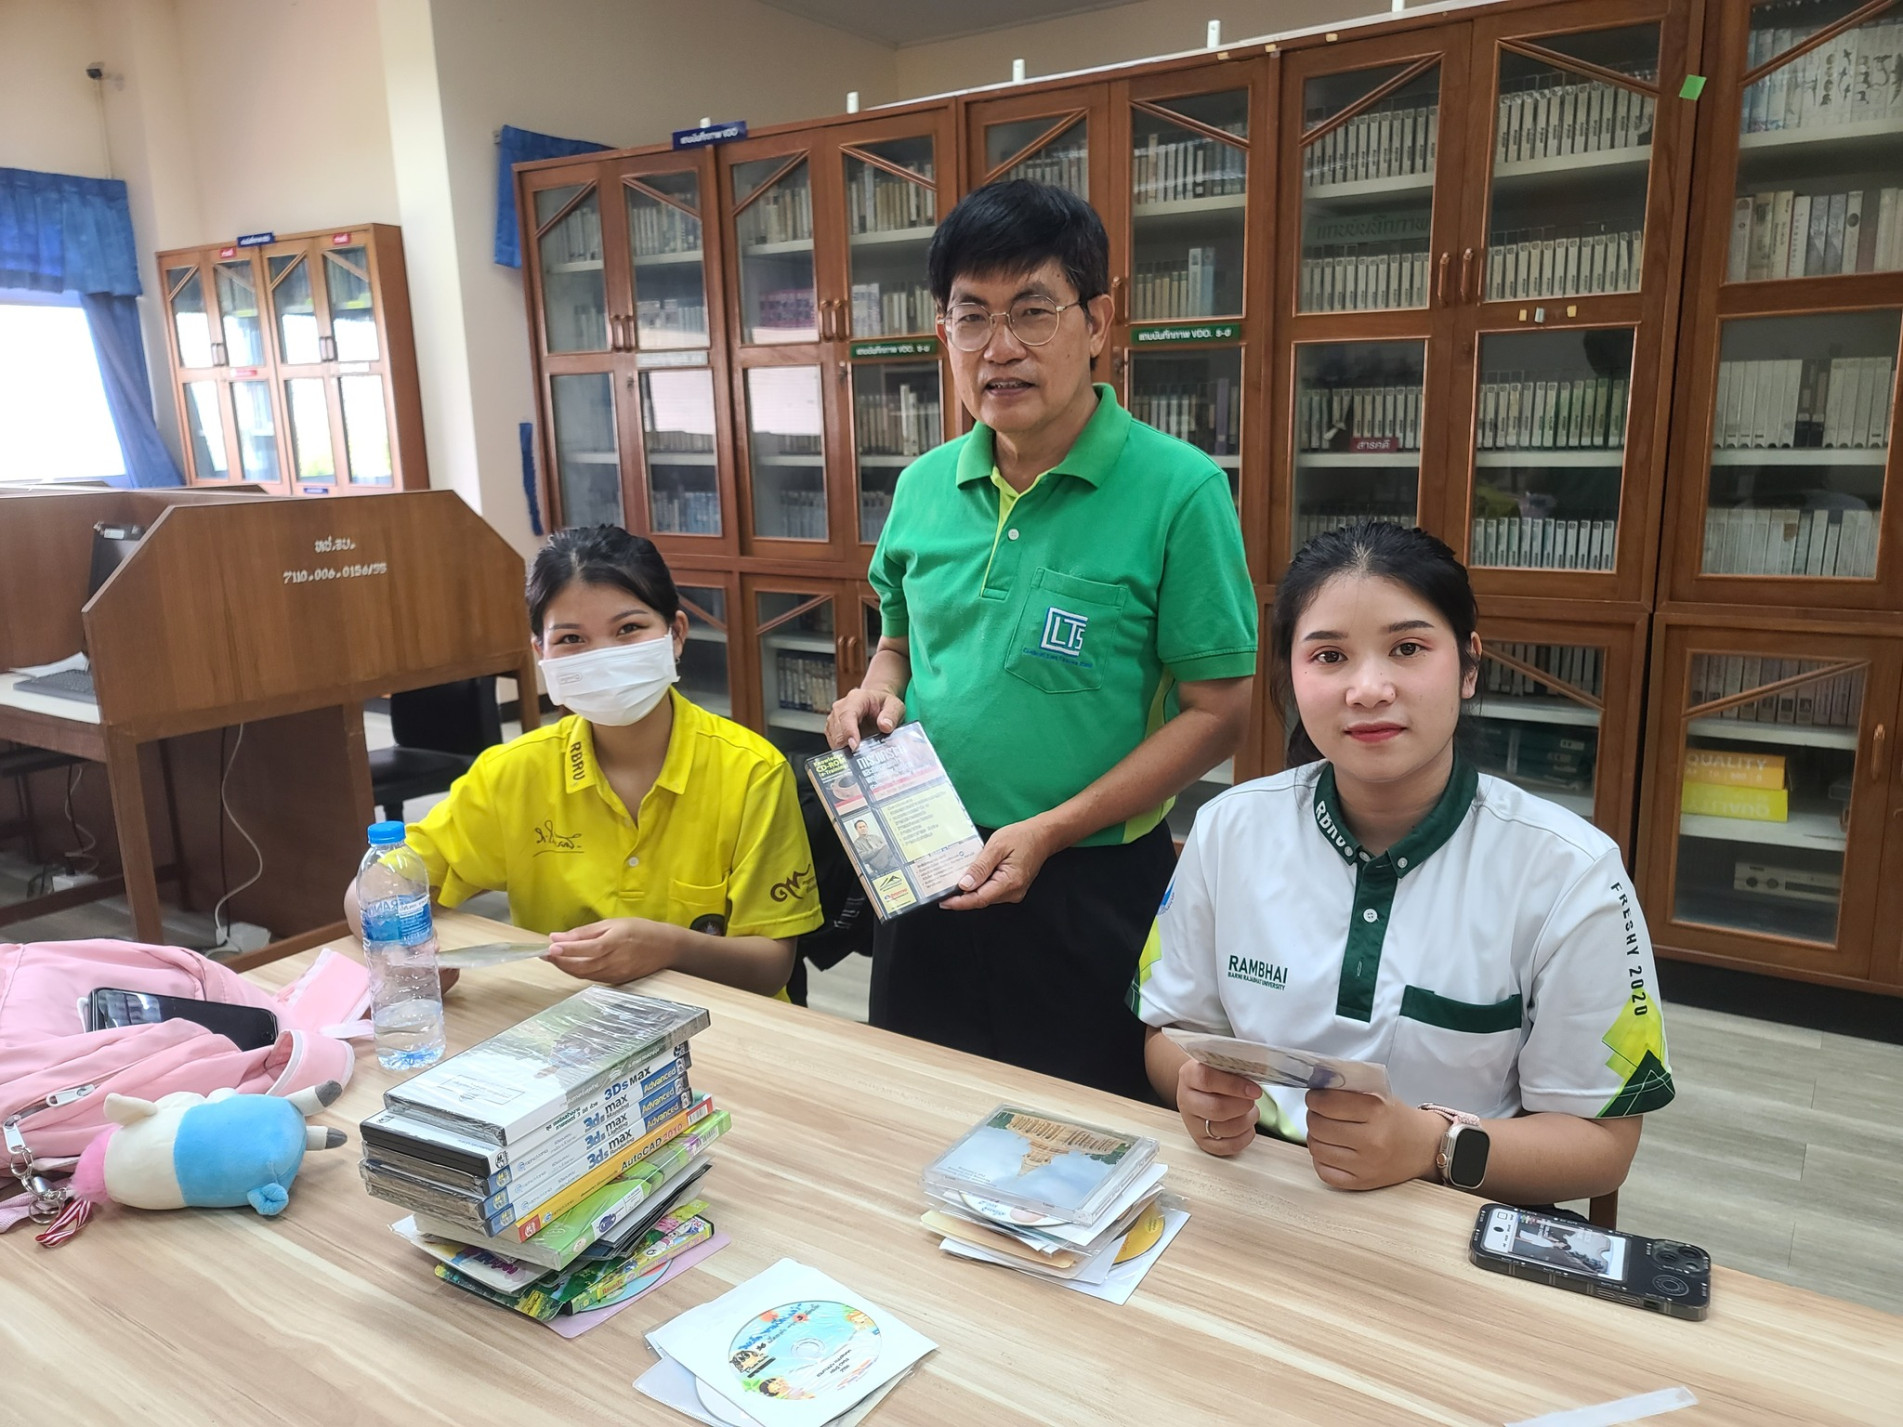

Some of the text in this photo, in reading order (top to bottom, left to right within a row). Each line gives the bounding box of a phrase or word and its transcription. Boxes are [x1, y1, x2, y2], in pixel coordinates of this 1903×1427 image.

[1356, 439, 1391, 450] สารคดี
[569, 741, 586, 781] RBRU
[1686, 752, 1768, 771] QUALITY
[1610, 881, 1648, 1016] FRESHY 2020
[1228, 954, 1289, 984] RAMBHAI
[605, 1094, 628, 1114] max
[643, 1067, 677, 1093] Advanced
[606, 1113, 628, 1133] max
[642, 1087, 675, 1113] Advanced
[587, 1148, 609, 1170] 3ds
[608, 1129, 633, 1150] max
[647, 1102, 680, 1129] Advanced
[621, 1137, 662, 1171] AutoCAD
